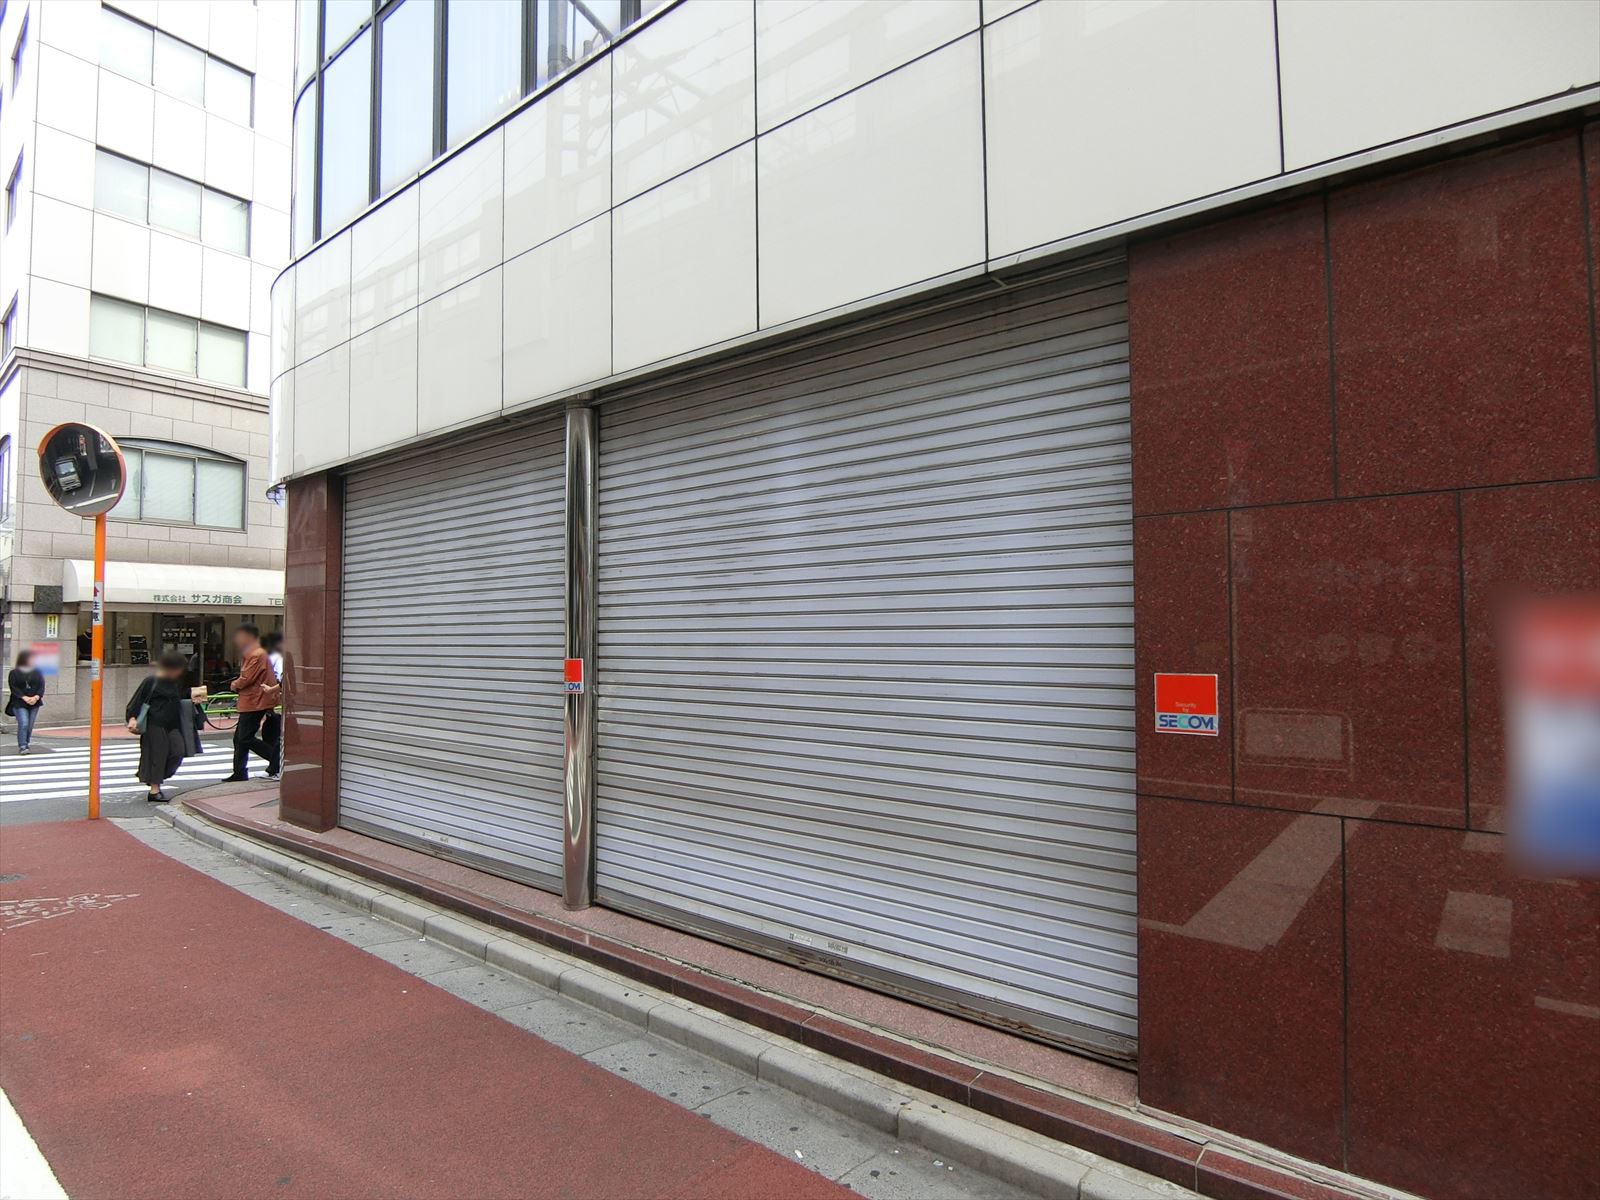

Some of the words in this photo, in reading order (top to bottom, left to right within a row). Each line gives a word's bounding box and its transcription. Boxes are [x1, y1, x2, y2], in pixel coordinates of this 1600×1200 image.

[153, 594, 187, 603] 株式会社
[191, 593, 243, 604] サスガ商会
[1158, 714, 1214, 730] SECOM
